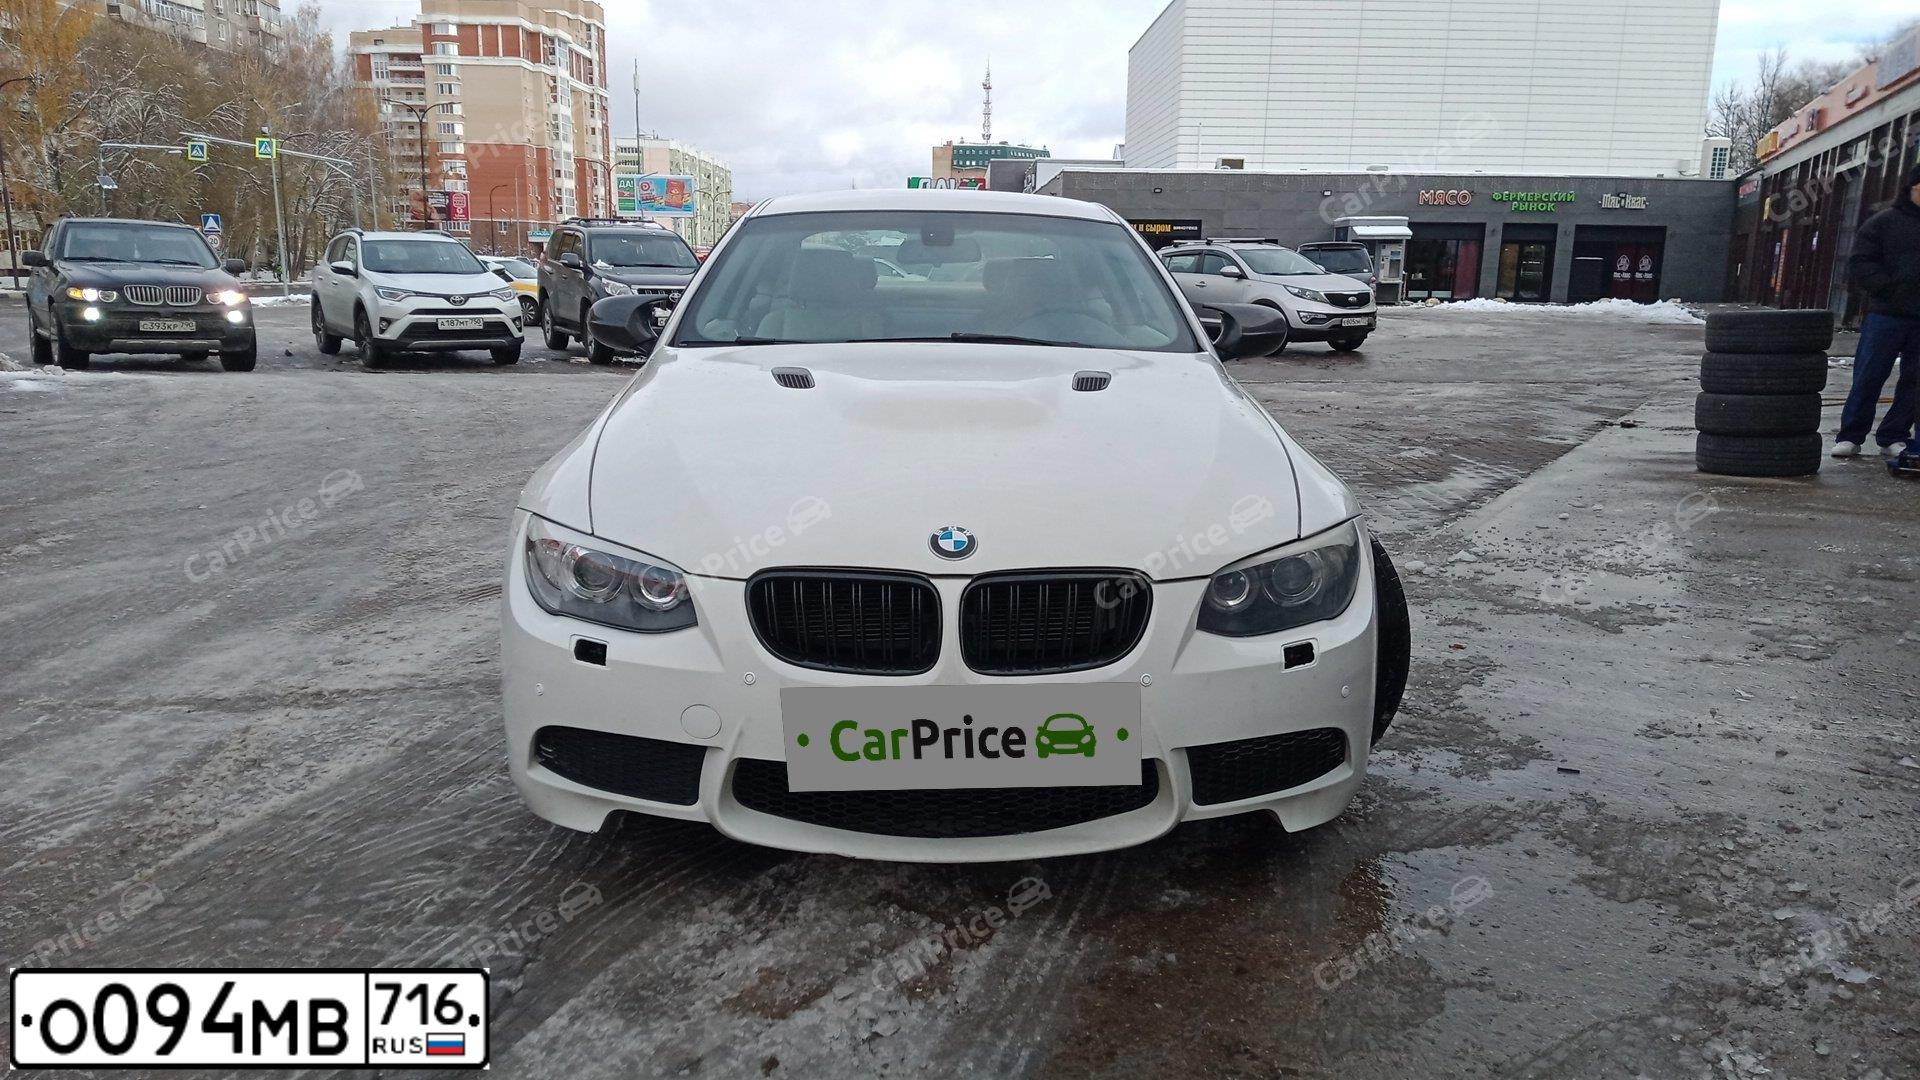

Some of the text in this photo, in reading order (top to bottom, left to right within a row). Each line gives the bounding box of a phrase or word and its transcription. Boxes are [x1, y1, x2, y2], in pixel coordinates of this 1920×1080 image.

[1418, 190, 1472, 206] МЯСО
[1492, 190, 1576, 203] ФЕРМЕРСКИЙ
[1511, 201, 1556, 212] РЫНОК
